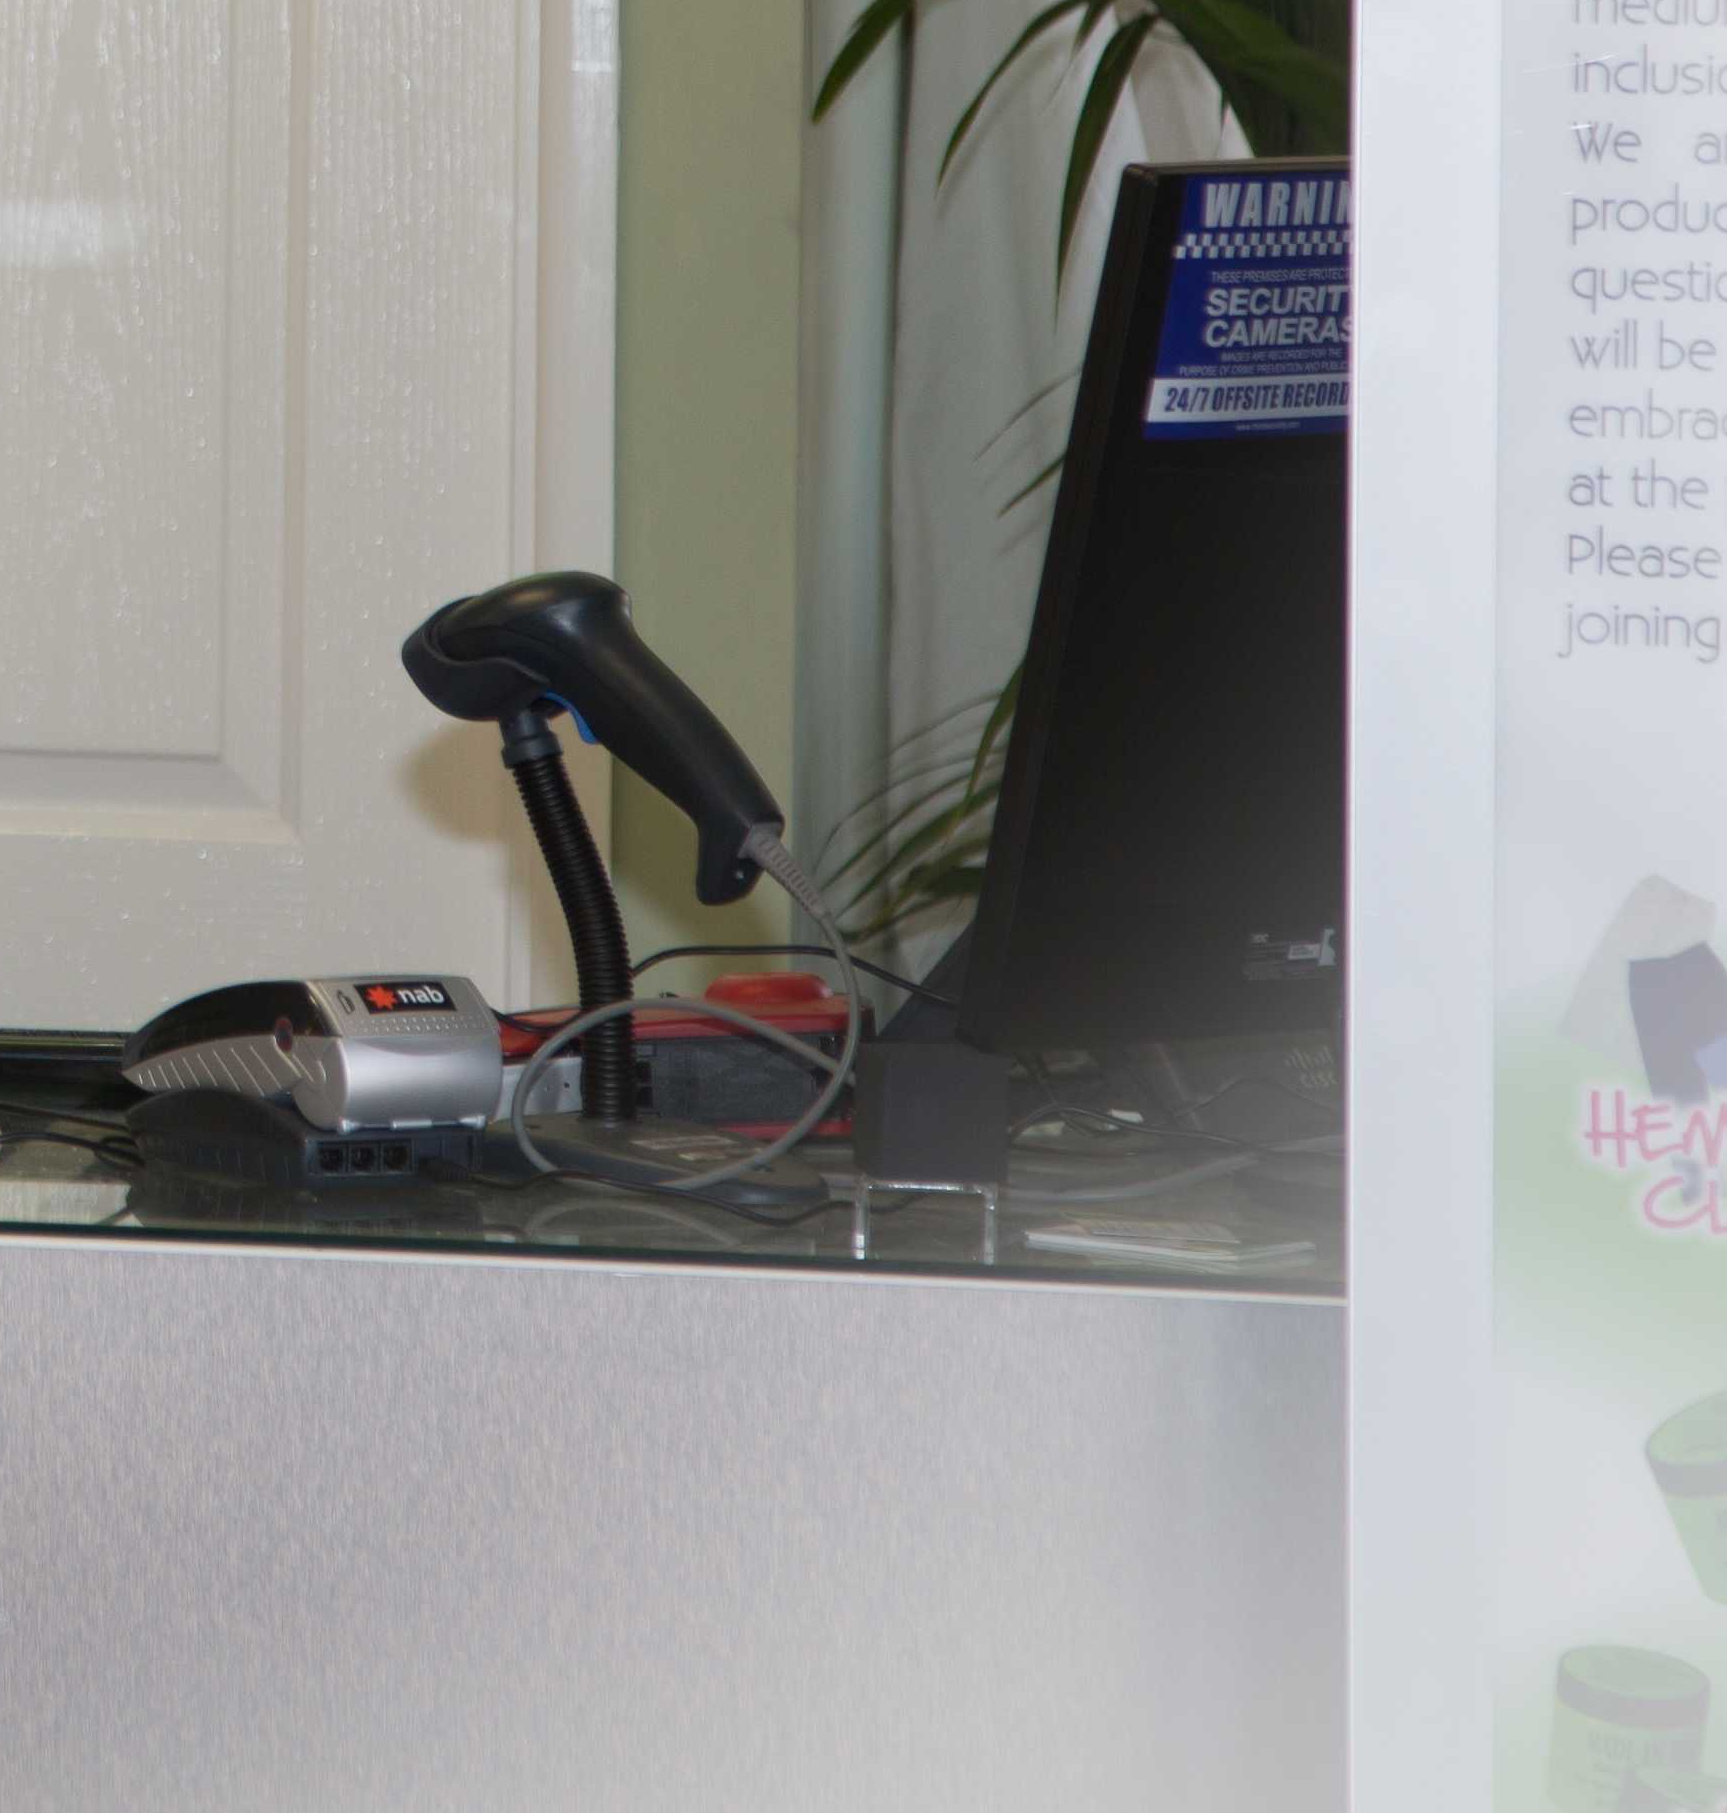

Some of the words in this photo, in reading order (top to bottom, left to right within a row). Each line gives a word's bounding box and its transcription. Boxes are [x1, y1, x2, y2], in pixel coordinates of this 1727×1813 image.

[1569, 320, 1639, 371] will
[1658, 320, 1717, 373] be
[1567, 524, 1721, 579] Please
[1556, 603, 1721, 663] joining
[397, 982, 446, 1005] nab
